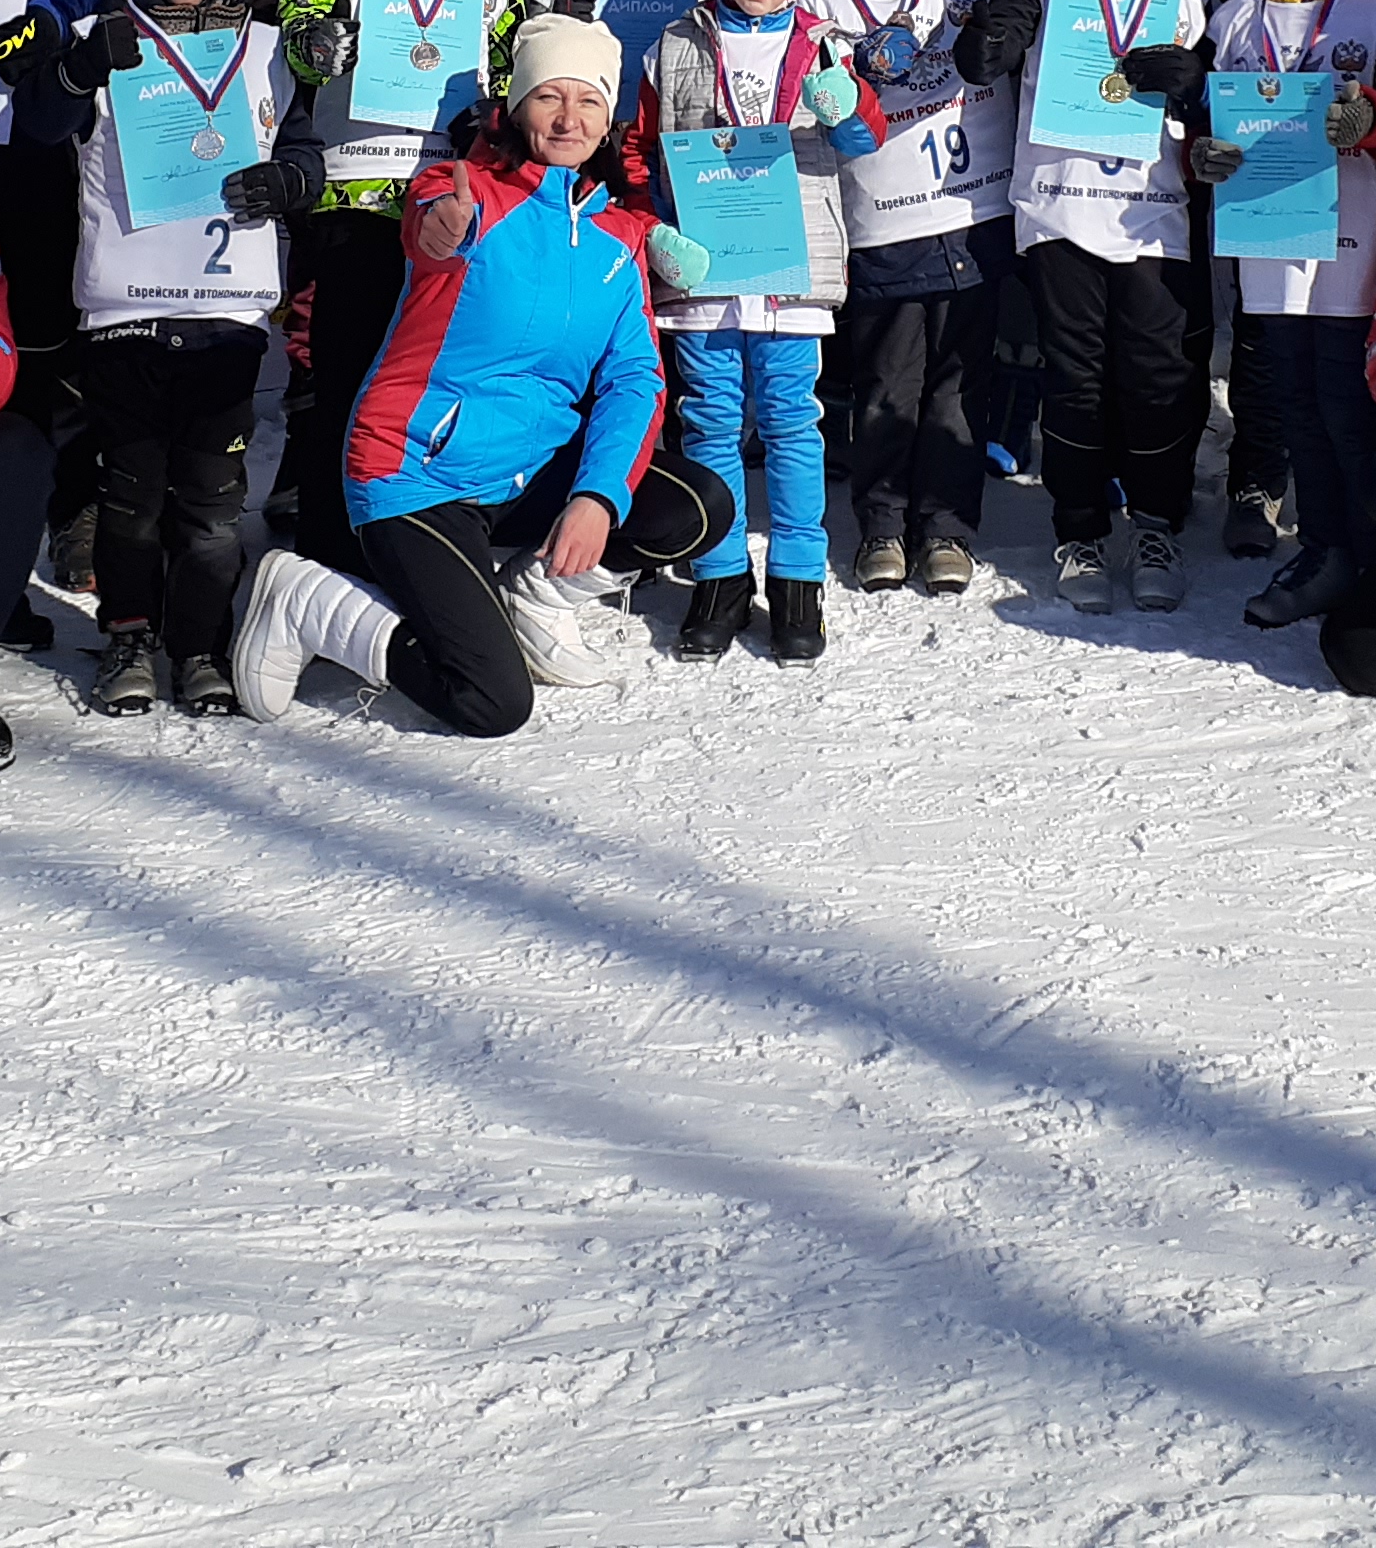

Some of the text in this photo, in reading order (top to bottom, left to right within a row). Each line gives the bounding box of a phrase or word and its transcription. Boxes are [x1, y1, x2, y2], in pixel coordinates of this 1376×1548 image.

[607, 1, 674, 13] ДИПЛОМ
[732, 70, 765, 88] ЖНЯ
[886, 87, 995, 125] ЖНЯ РОССИИ 2018
[1235, 118, 1309, 135] ДИПЛОМ
[339, 143, 455, 159] Еврейская автономная
[920, 124, 971, 181] 19
[697, 166, 770, 184] ДИПЛОМ
[874, 193, 928, 211] Еврейская
[930, 178, 985, 201] автономная
[1037, 181, 1144, 202] Еврейская автономная
[203, 218, 232, 275] 2
[127, 285, 253, 300] Еврейская автономная
